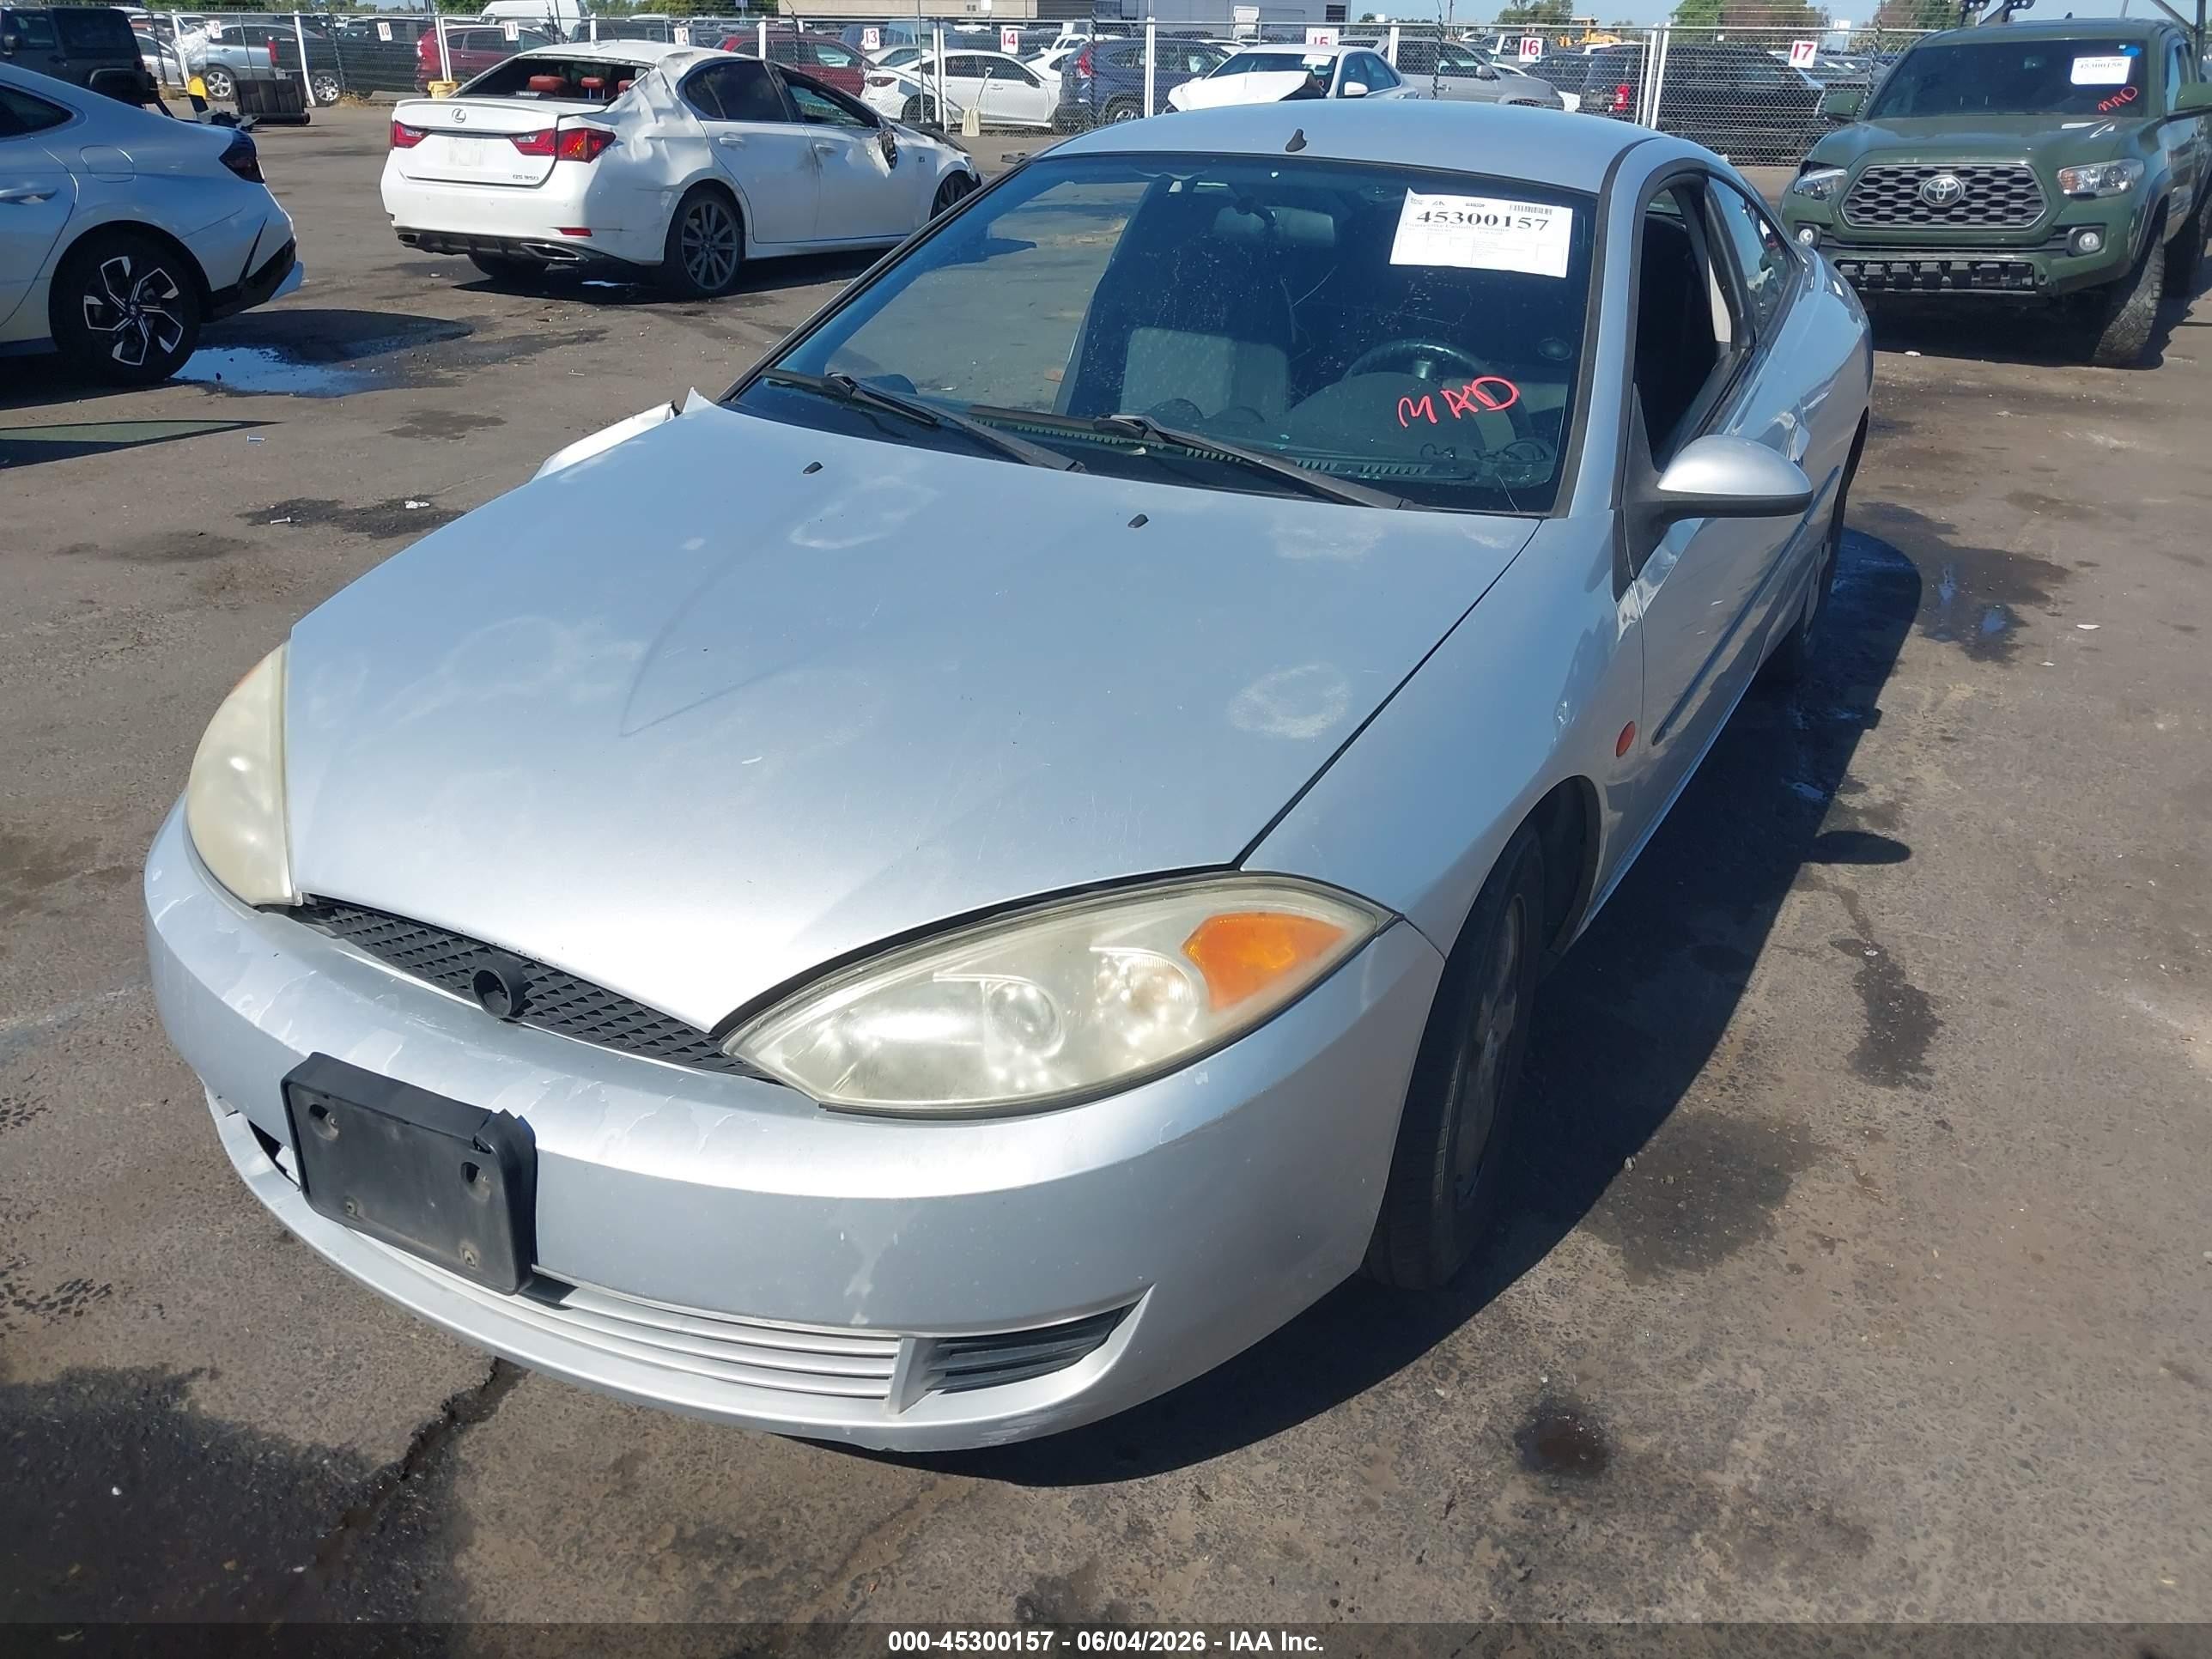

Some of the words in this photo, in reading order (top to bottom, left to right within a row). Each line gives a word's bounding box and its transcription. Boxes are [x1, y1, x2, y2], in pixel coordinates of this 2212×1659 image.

[213, 22, 220, 33] 9
[380, 24, 390, 36] 10
[506, 23, 517, 35] 11
[677, 29, 687, 42] 12
[866, 30, 878, 44] 13
[1002, 33, 1016, 46] 14
[1522, 40, 1540, 56] 16
[1792, 43, 1814, 60] 17
[2098, 86, 2138, 112] MAD
[1417, 211, 1550, 232] 45300157
[1398, 376, 1521, 428] MAD
